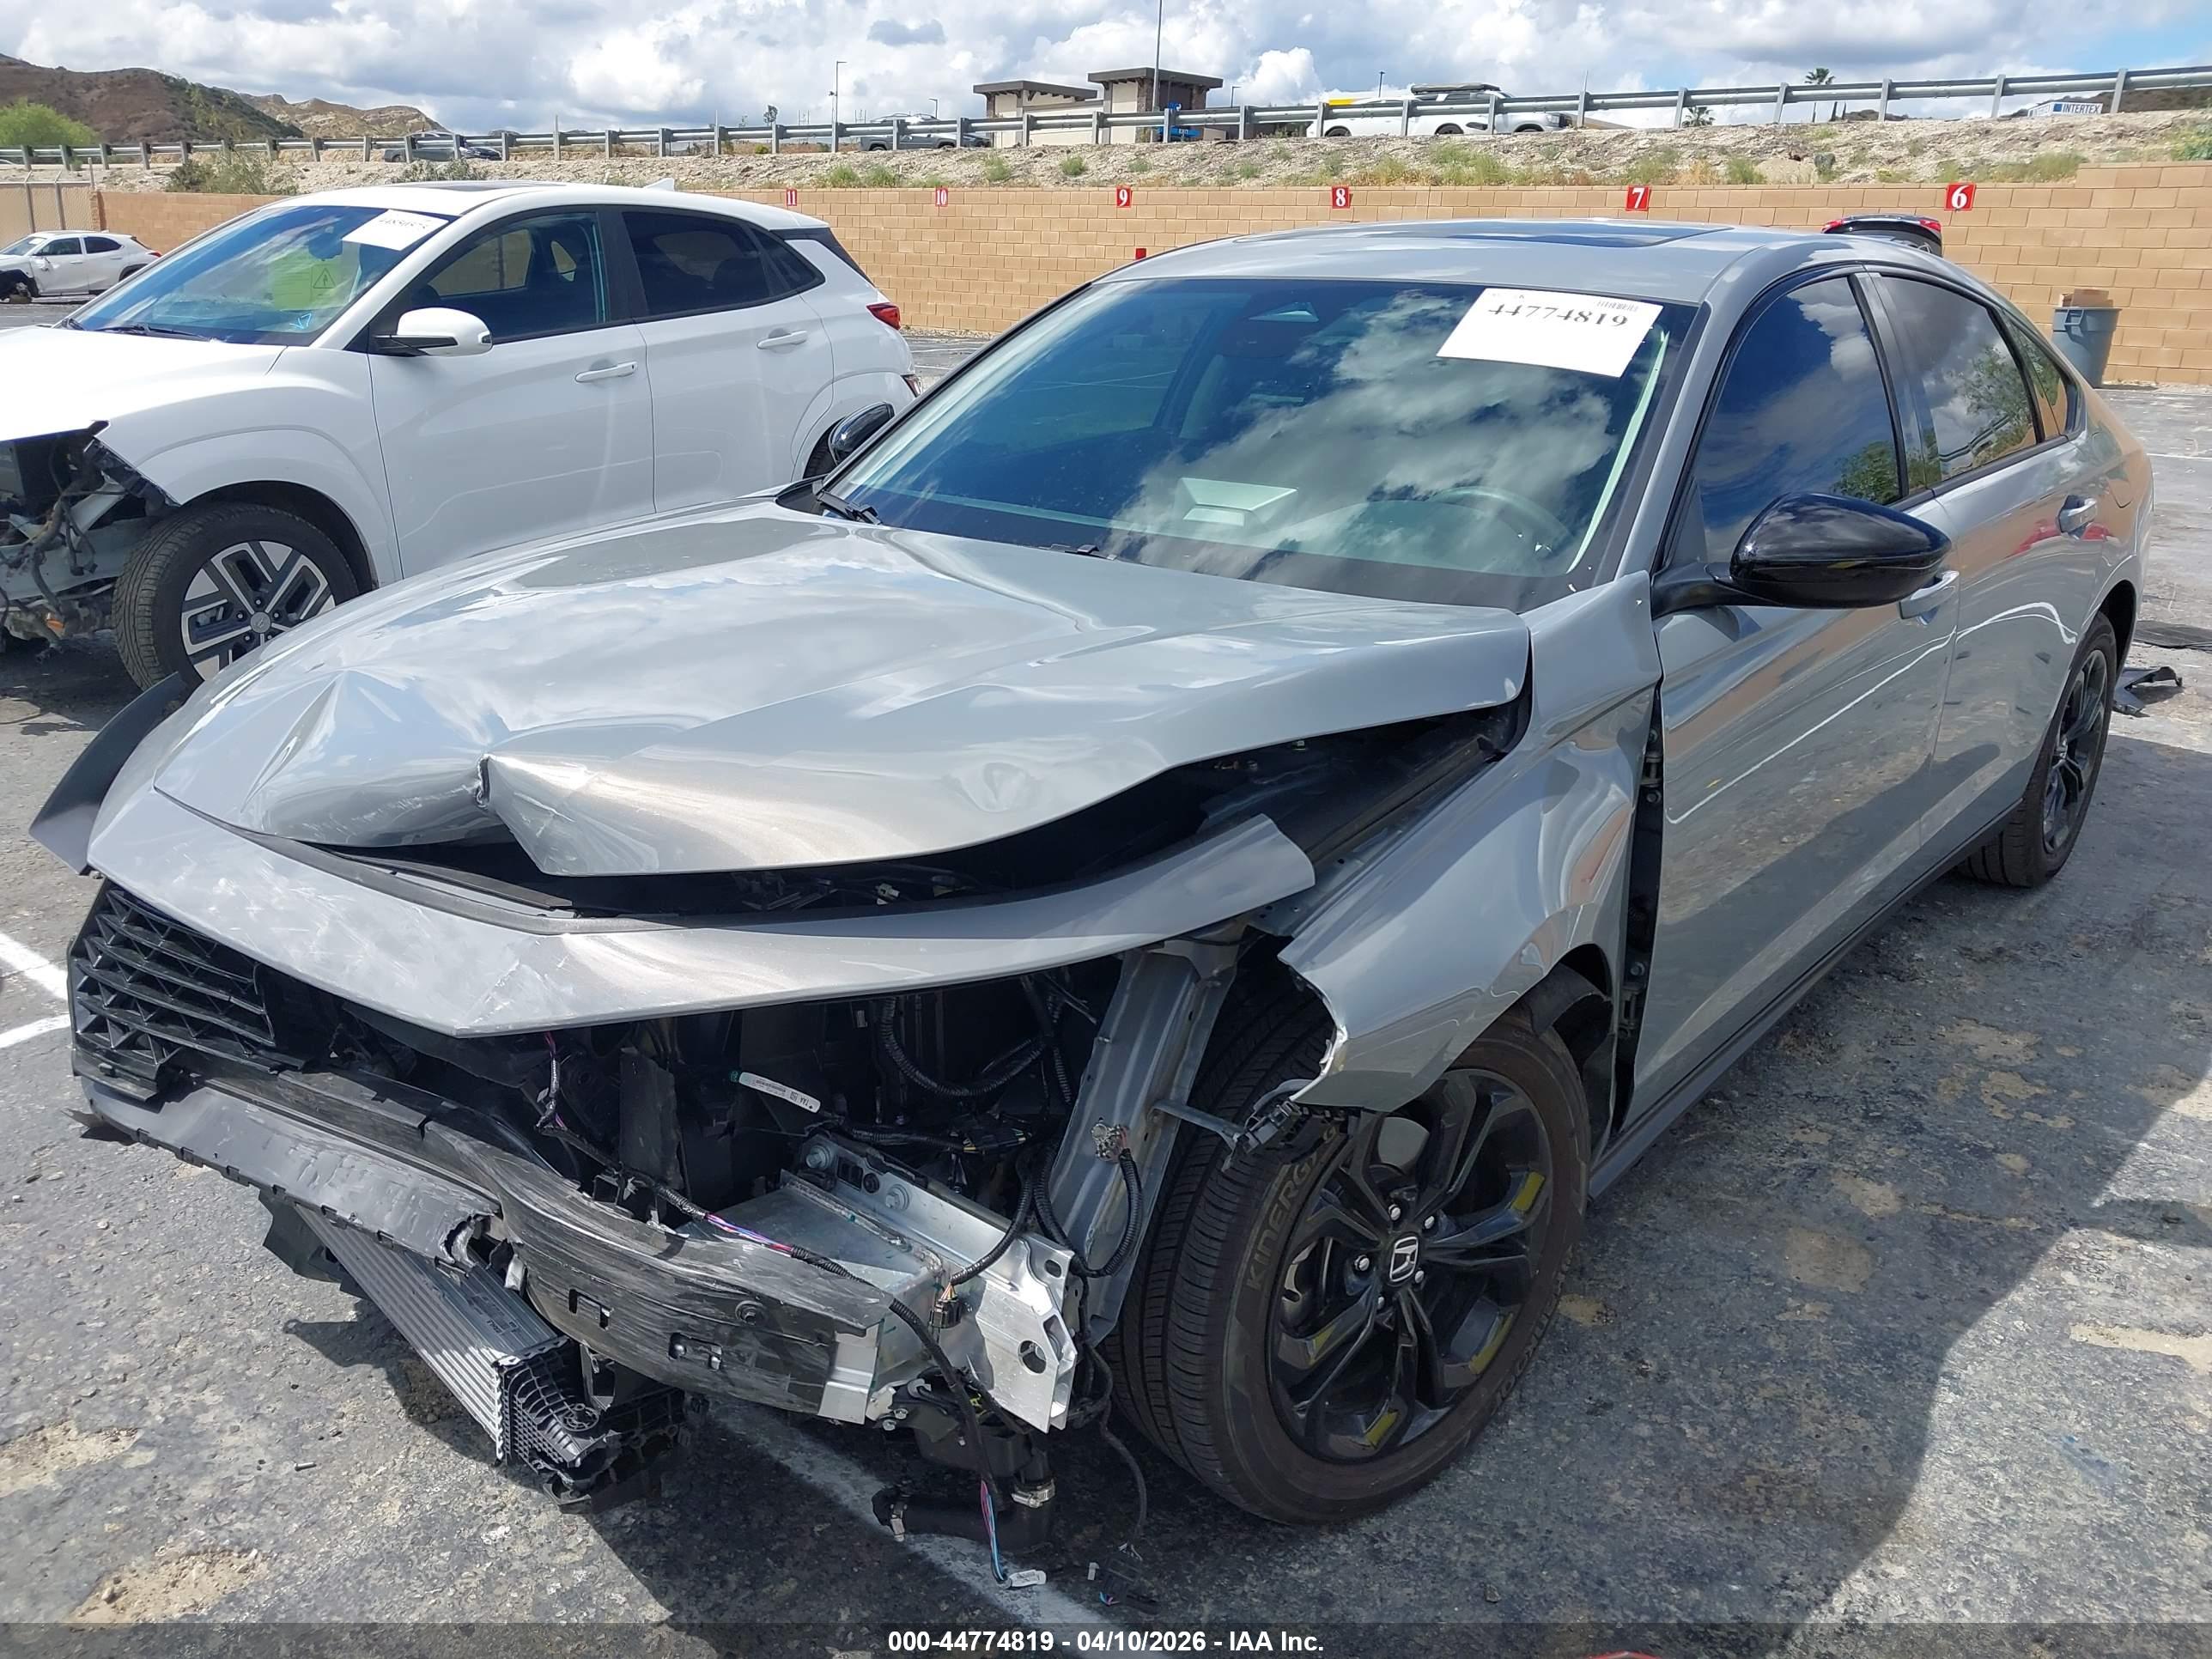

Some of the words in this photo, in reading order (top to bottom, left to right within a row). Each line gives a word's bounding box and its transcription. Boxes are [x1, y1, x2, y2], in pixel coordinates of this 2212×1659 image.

[2063, 104, 2100, 114] INTERTEX
[787, 191, 796, 205] 11
[936, 190, 947, 205] 10
[1118, 189, 1127, 206] 9
[1335, 188, 1346, 207] 8
[1632, 188, 1645, 209] 7
[1951, 185, 1968, 209] 6
[1488, 302, 1628, 327] 44774819
